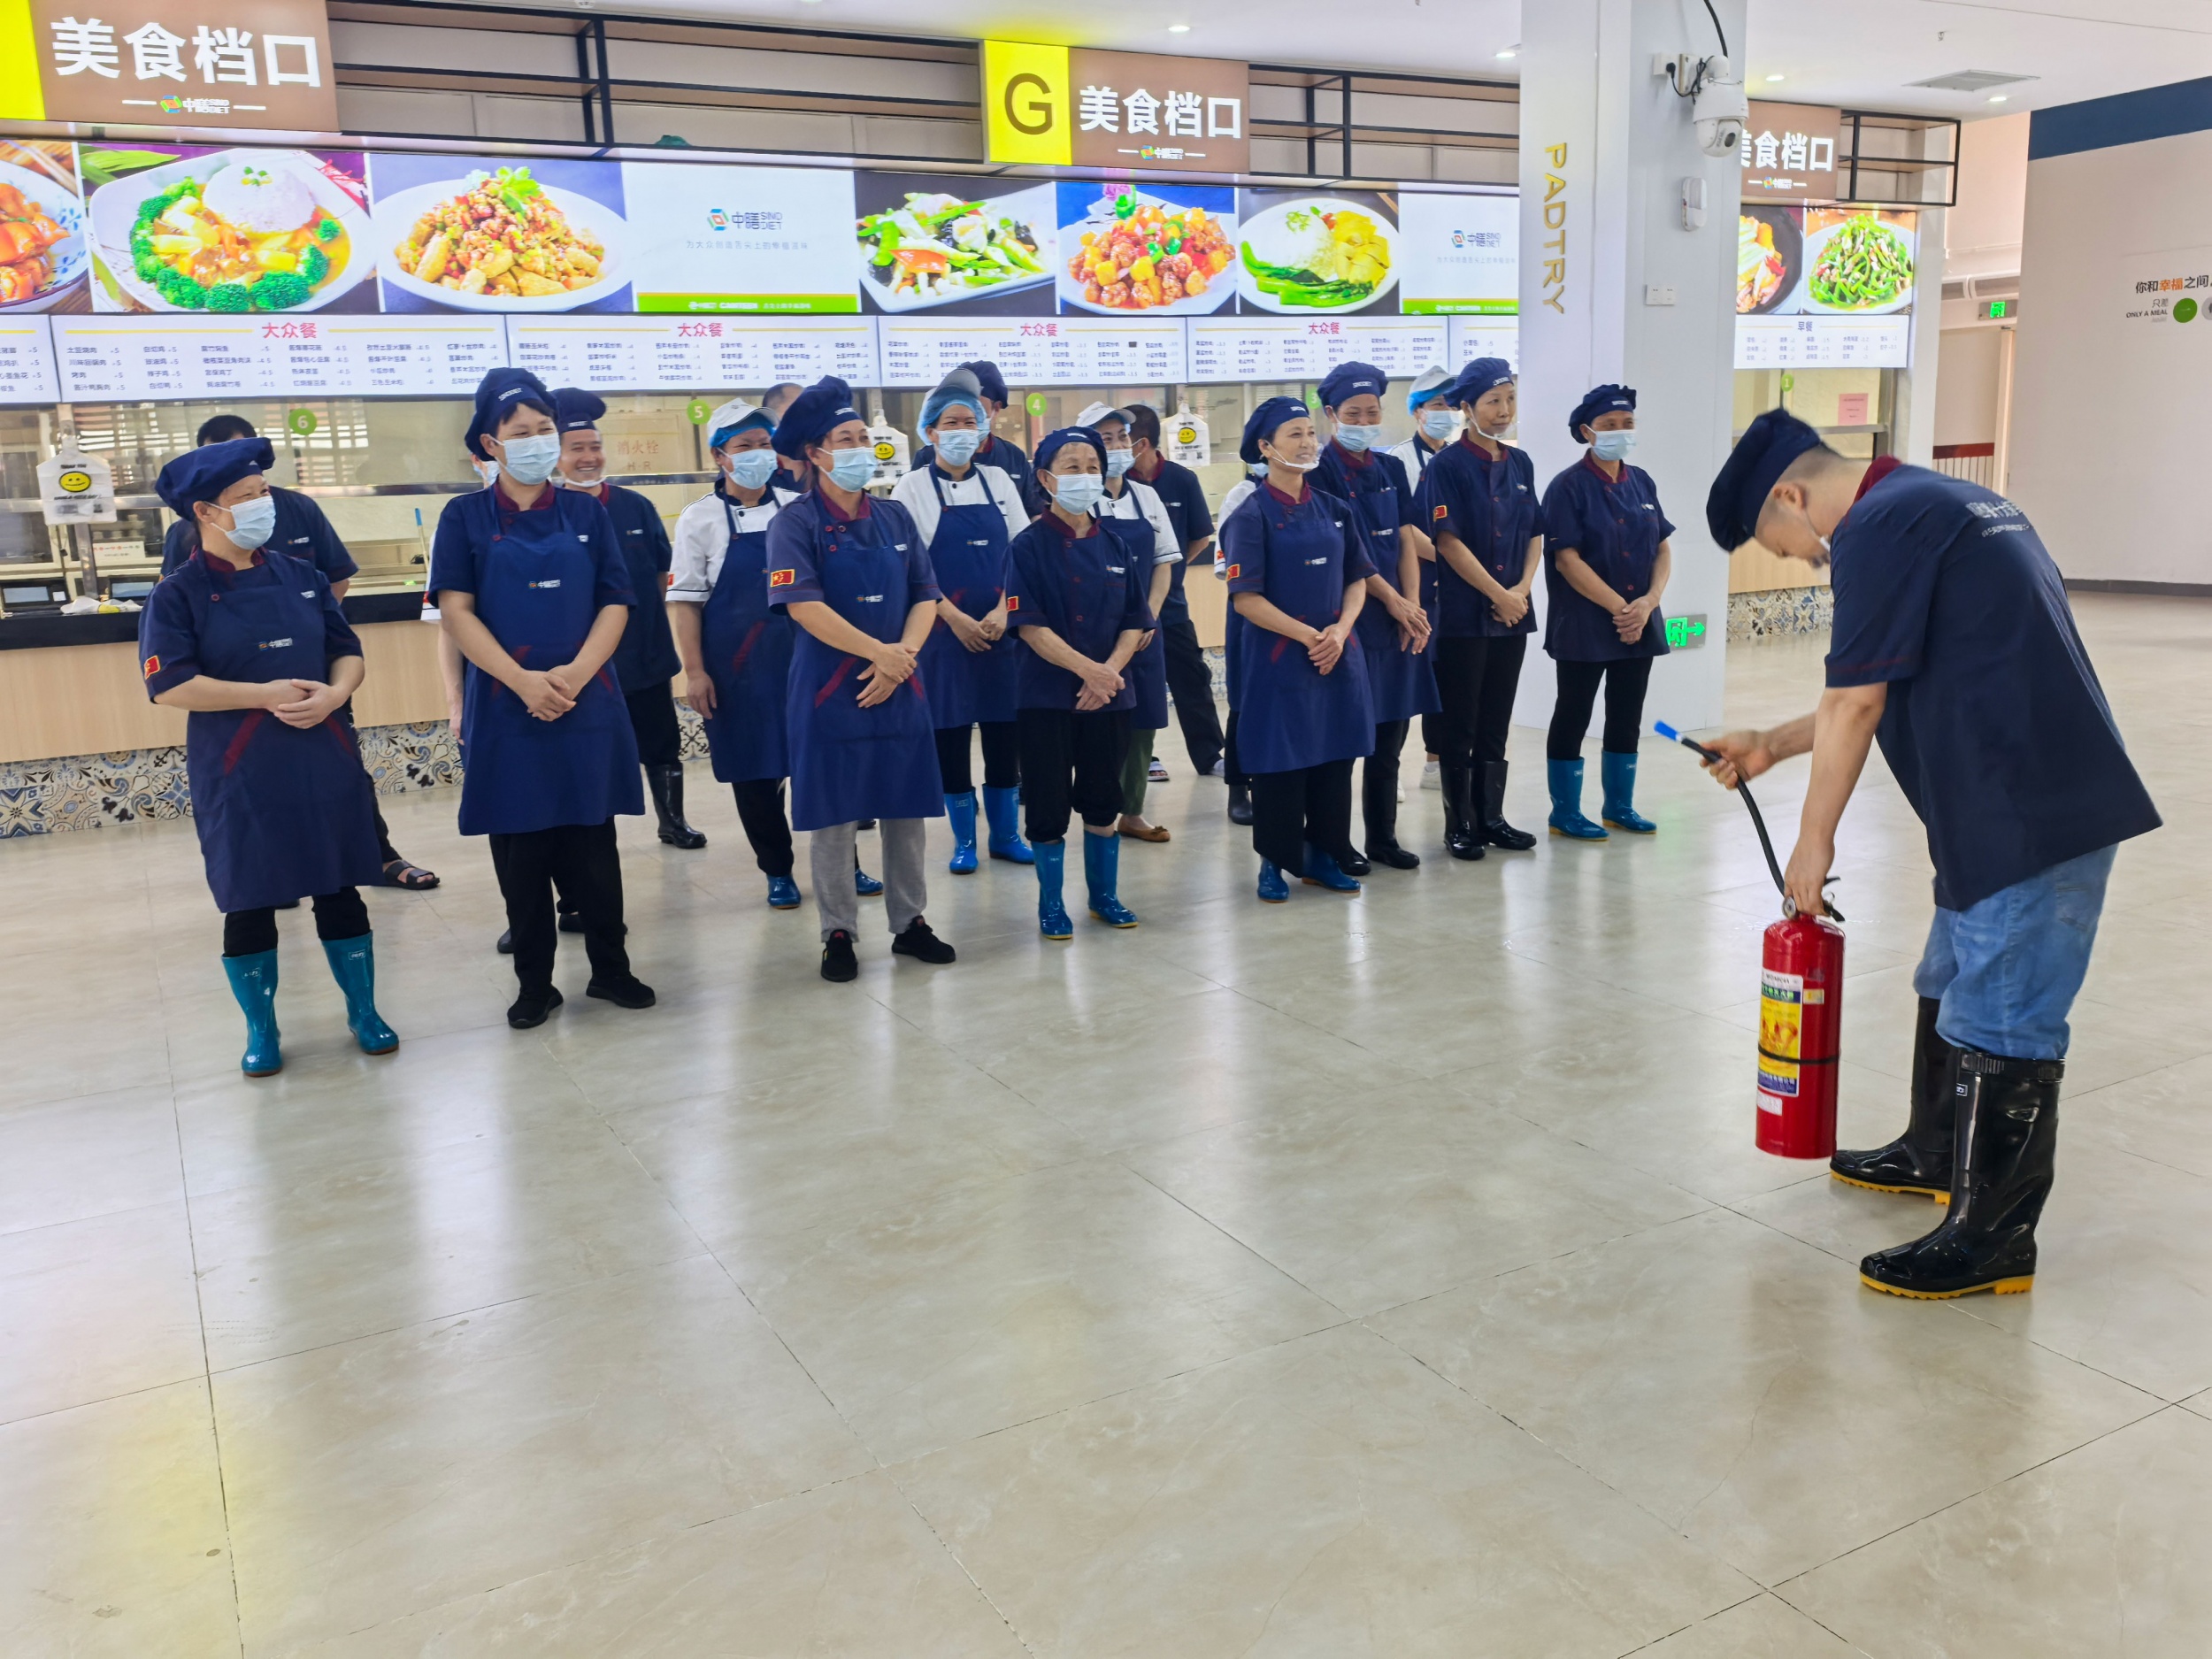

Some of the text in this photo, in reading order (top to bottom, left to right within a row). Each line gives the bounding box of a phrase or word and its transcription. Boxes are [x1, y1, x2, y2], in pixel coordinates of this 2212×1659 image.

[50, 16, 320, 88] 美食档口
[1004, 73, 1054, 135] G
[1079, 85, 1241, 139] 美食档口
[1542, 142, 1567, 314] PADTRY
[2135, 275, 2209, 294] 你和幸福之间
[262, 322, 318, 339] 大众餐
[678, 322, 724, 337] 大众餐
[1020, 323, 1058, 337] 大众餐
[1308, 322, 1340, 334] 大众餐
[694, 405, 703, 419] 5
[1032, 398, 1041, 411] 4
[297, 415, 308, 428] 6
